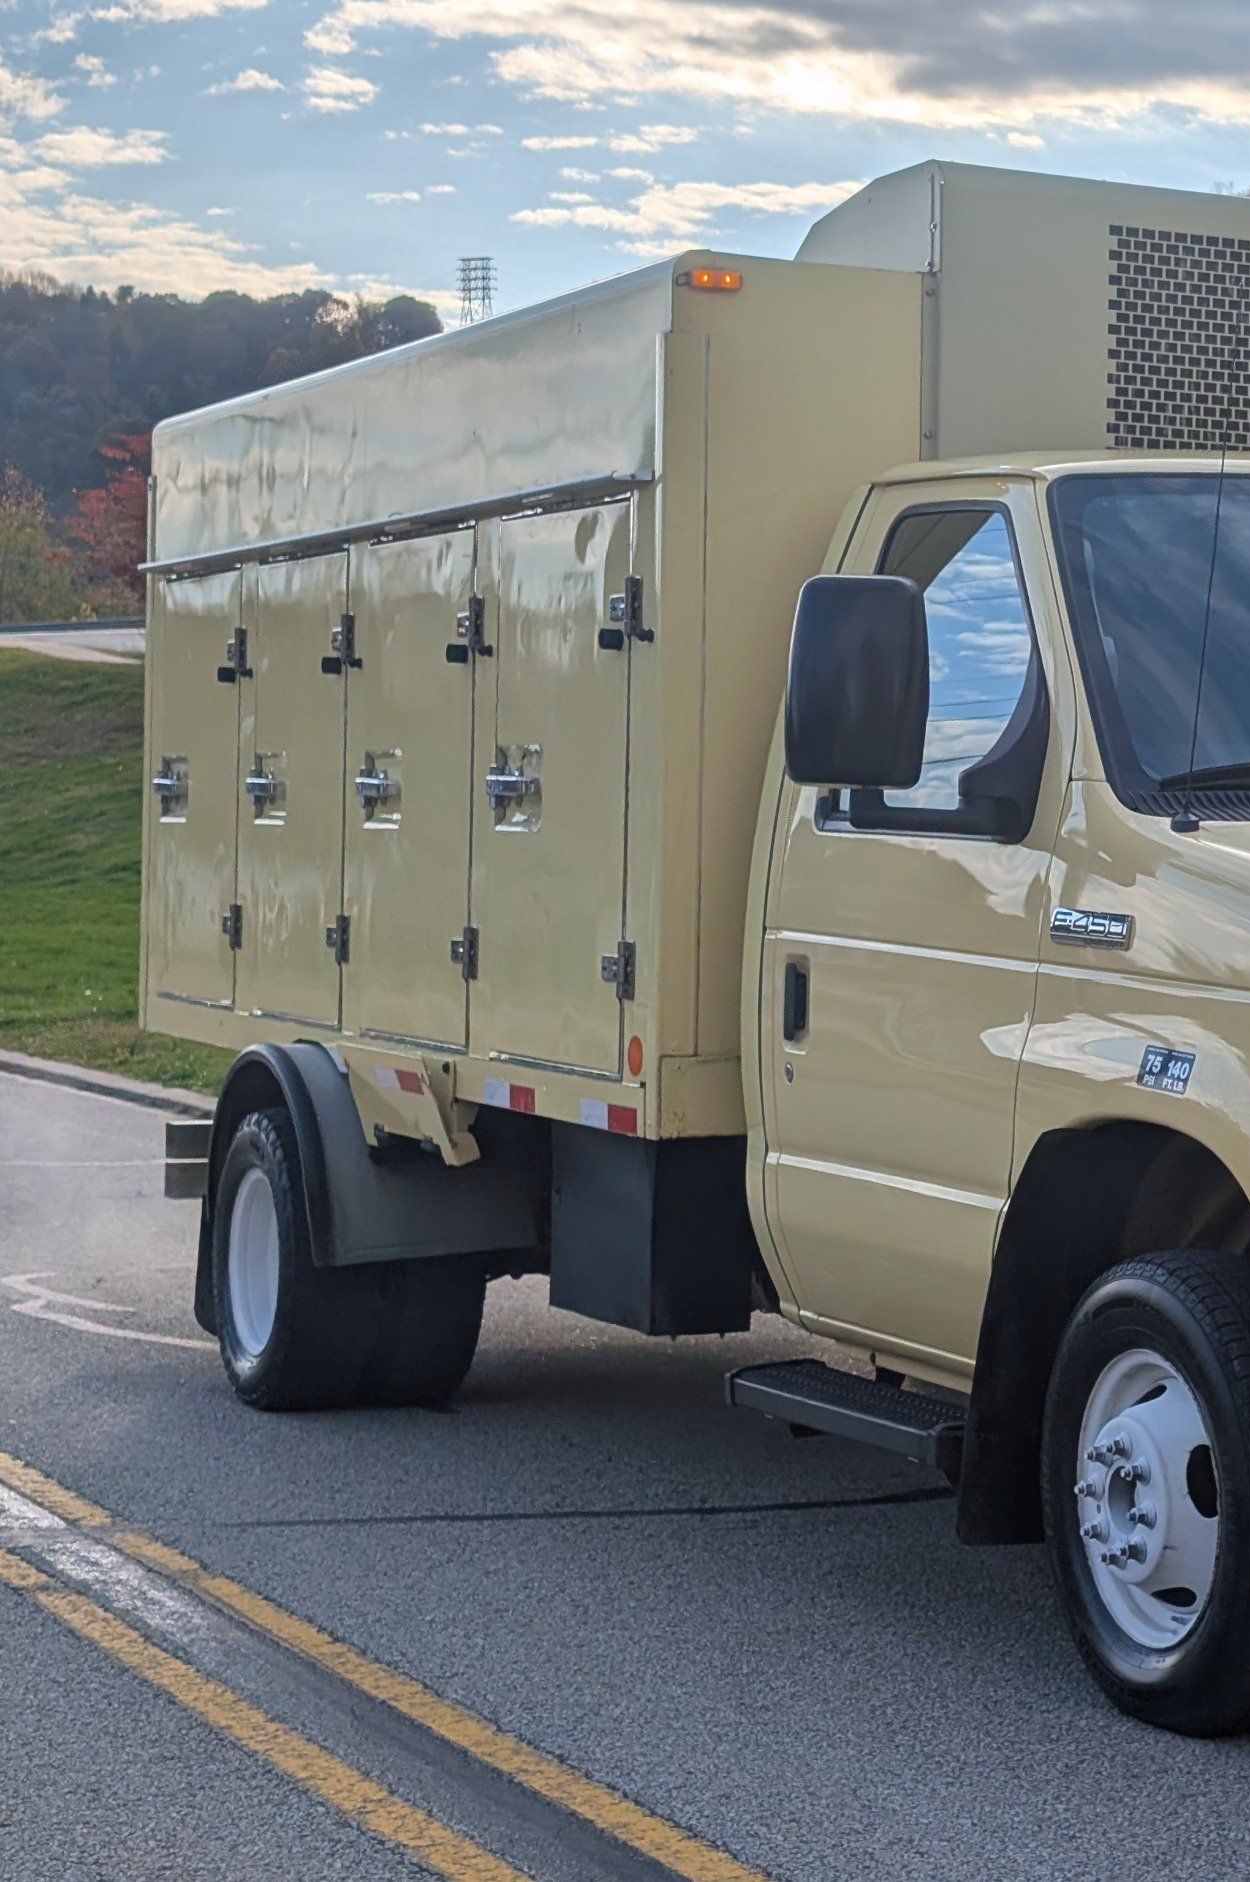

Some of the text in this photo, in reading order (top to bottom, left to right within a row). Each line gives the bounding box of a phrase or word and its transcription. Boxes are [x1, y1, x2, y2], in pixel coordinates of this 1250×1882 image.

[1145, 1054, 1190, 1080] 75 140
[1142, 1074, 1156, 1086] PSI
